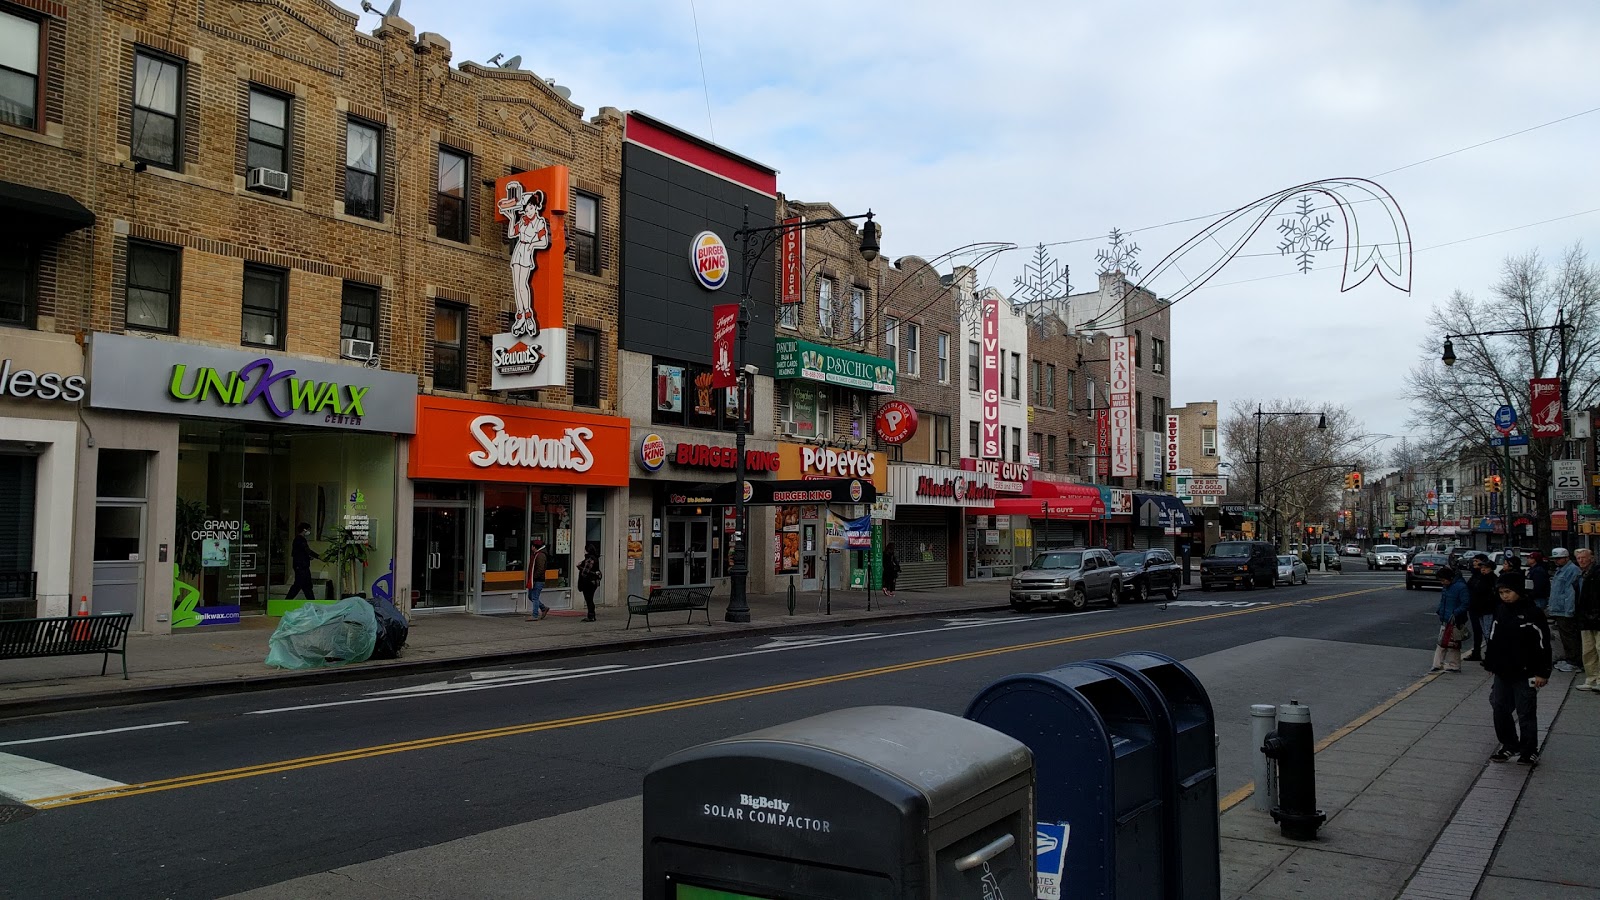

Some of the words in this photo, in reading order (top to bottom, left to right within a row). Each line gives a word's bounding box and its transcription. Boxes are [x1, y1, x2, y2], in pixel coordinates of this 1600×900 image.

[698, 246, 724, 259] BURGER
[699, 255, 726, 272] KING
[984, 304, 997, 369] FIVE
[826, 356, 873, 379] PSYCHIC
[1114, 341, 1127, 390] PRATO
[325, 415, 362, 425] CENTER
[878, 403, 914, 421] LOUISIANA
[886, 412, 905, 435] P
[984, 389, 998, 454] GUYS
[878, 431, 912, 446] KITCHEN
[1168, 422, 1177, 442] BUY
[643, 441, 664, 451] BURGER
[1114, 410, 1128, 473] OUTLETS
[644, 448, 664, 460] KING
[676, 443, 738, 468] BURGER
[746, 450, 780, 472] KING
[1168, 444, 1177, 471] GOLD
[976, 460, 999, 479] FIVE
[1002, 463, 1029, 481] GUYS
[1558, 476, 1580, 487] 25
[773, 491, 807, 501] BURGER
[809, 490, 833, 501] KING
[203, 520, 239, 530] GRAND
[191, 531, 239, 541] OPENING!
[195, 612, 239, 620] unikwax.com
[740, 794, 790, 813] BigBelly
[703, 803, 743, 820] SOLAR
[749, 810, 830, 833] COMPACTOR
